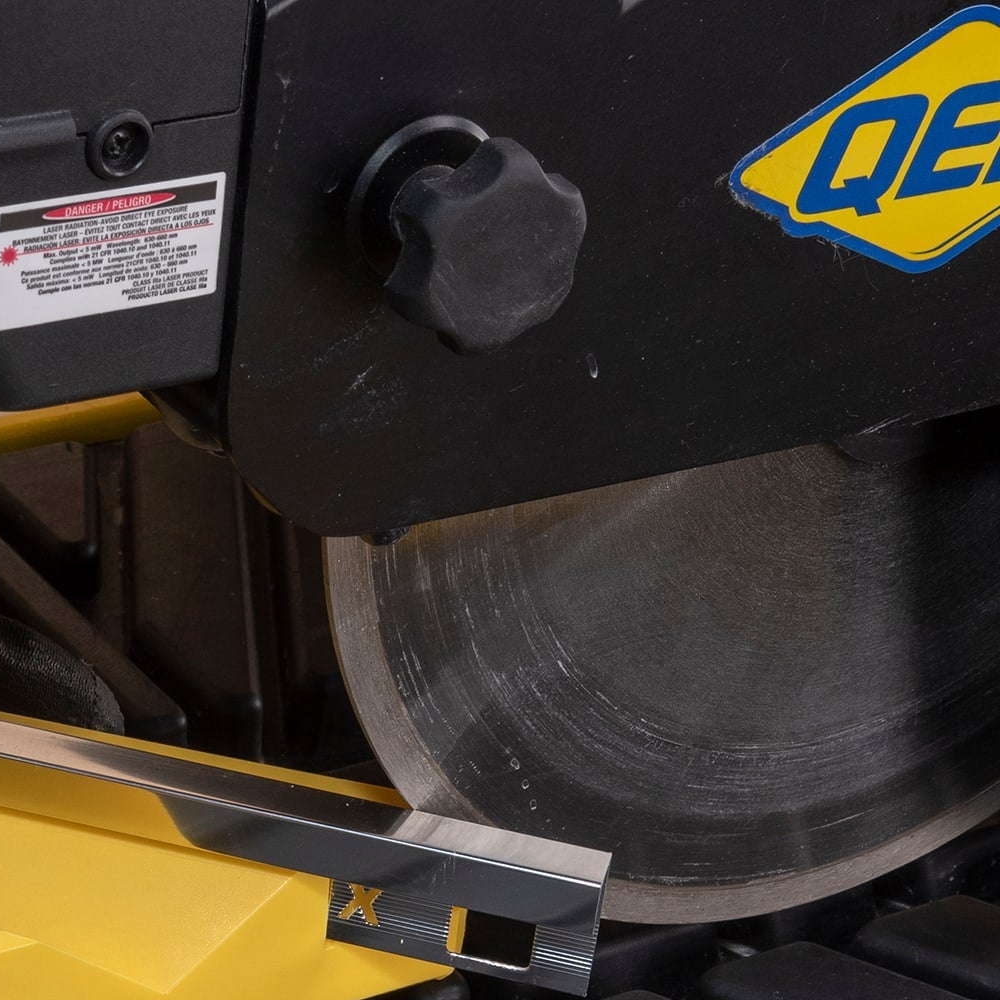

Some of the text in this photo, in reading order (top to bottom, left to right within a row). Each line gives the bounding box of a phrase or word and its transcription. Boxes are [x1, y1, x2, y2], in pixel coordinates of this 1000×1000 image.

[796, 79, 1000, 216] QE
[43, 225, 63, 234] LASER
[121, 213, 142, 222] DIRECT
[157, 206, 188, 216] EXPOSURE
[65, 203, 103, 216] DANGER
[112, 196, 152, 209] PELIGRO
[59, 231, 78, 239] LASER
[106, 224, 121, 232] TOUT
[122, 220, 148, 229] CONTACT
[150, 216, 171, 225] DIRECT
[172, 213, 187, 221] AVEC
[201, 209, 216, 217] YEUX
[148, 224, 173, 233] DIRECTA
[337, 883, 383, 927] X
